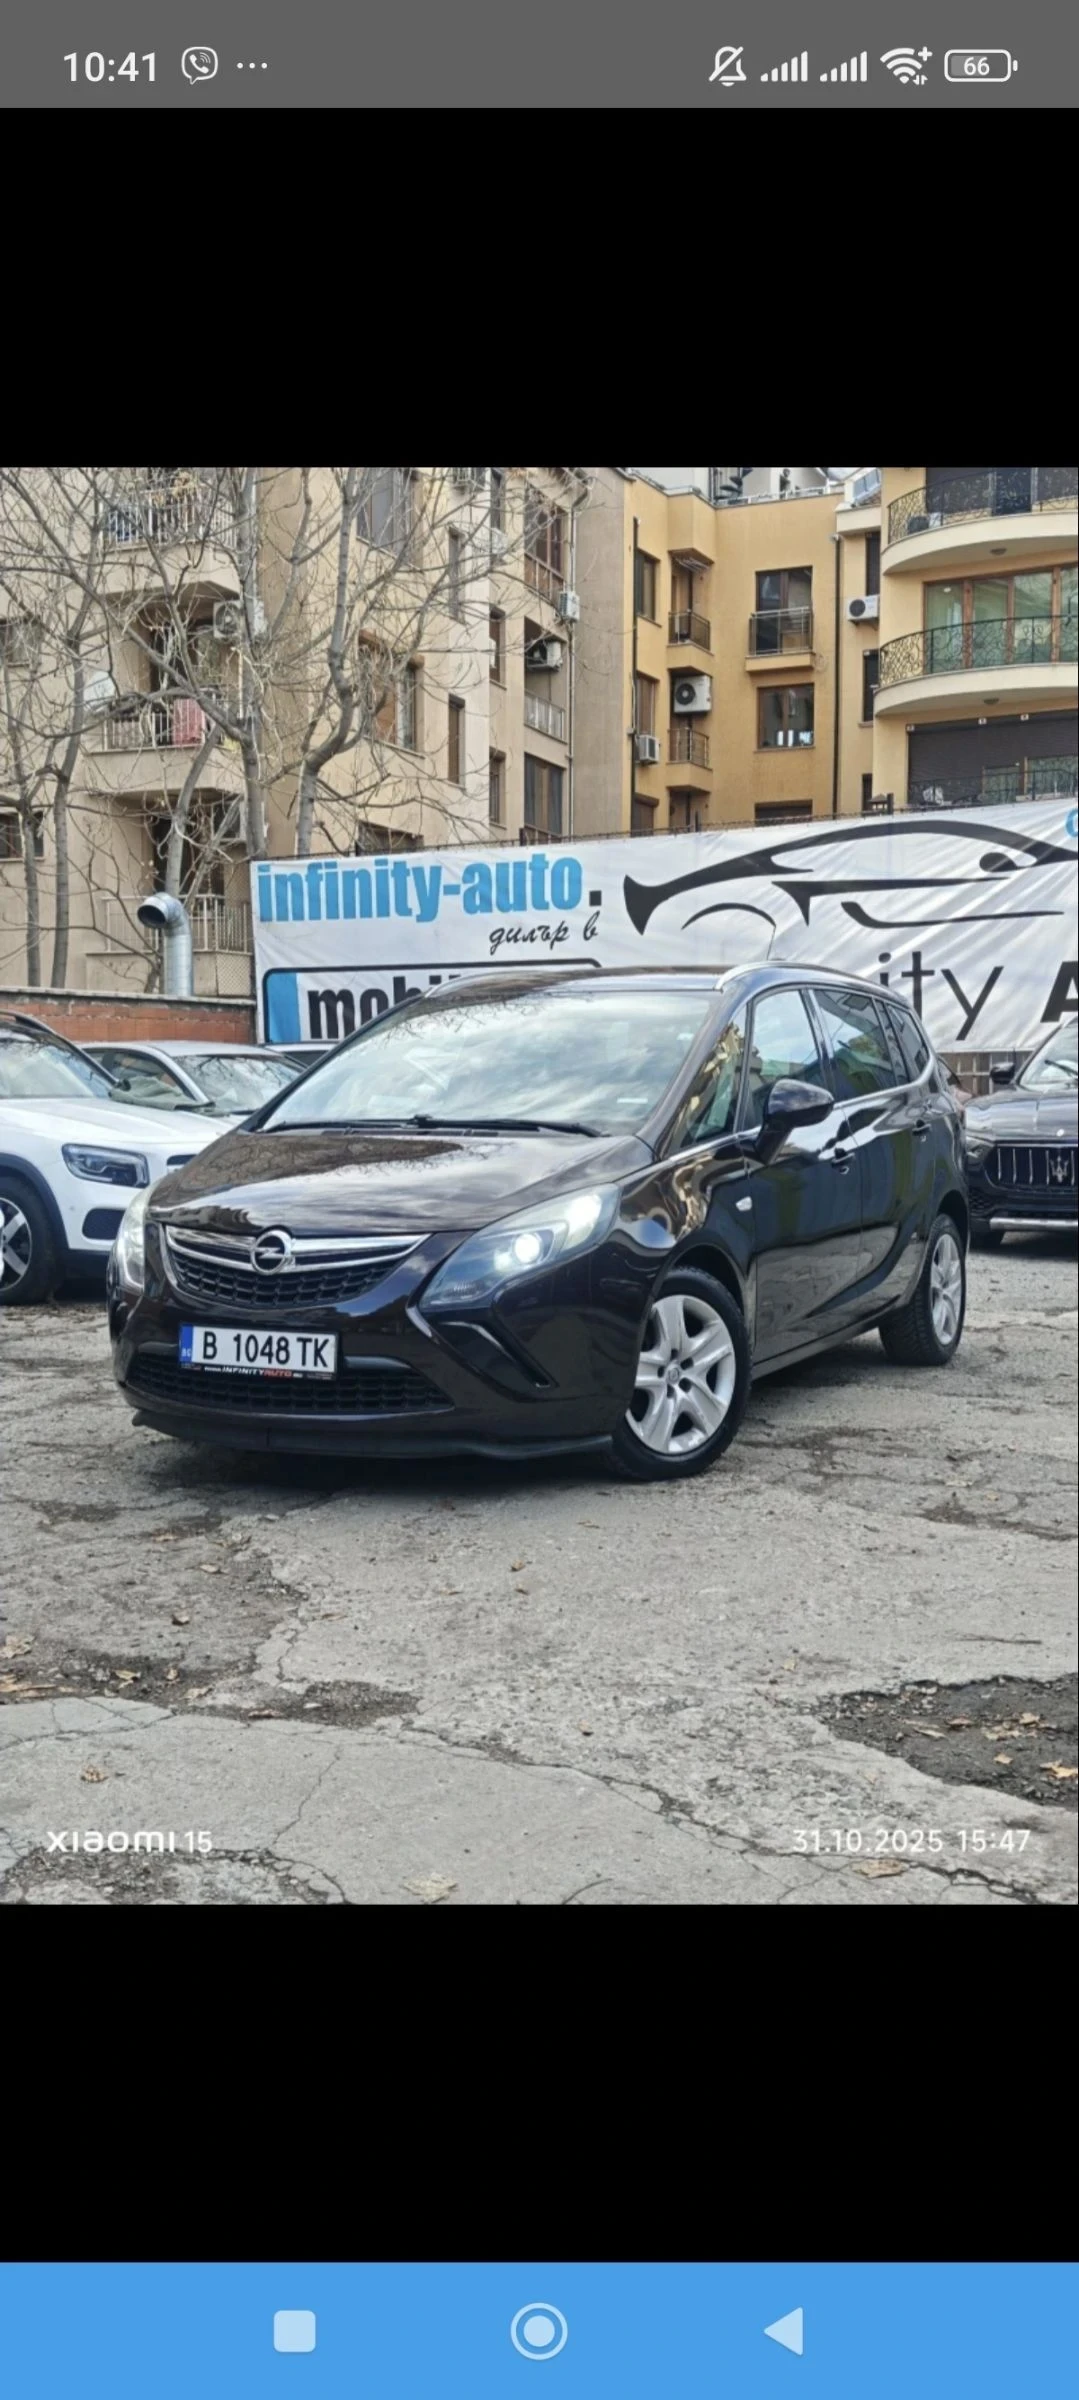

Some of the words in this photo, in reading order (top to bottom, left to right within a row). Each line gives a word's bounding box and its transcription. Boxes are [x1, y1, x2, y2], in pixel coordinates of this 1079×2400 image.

[203, 1331, 218, 1360] B
[233, 1333, 290, 1365] 1048
[297, 1337, 330, 1368] TK
